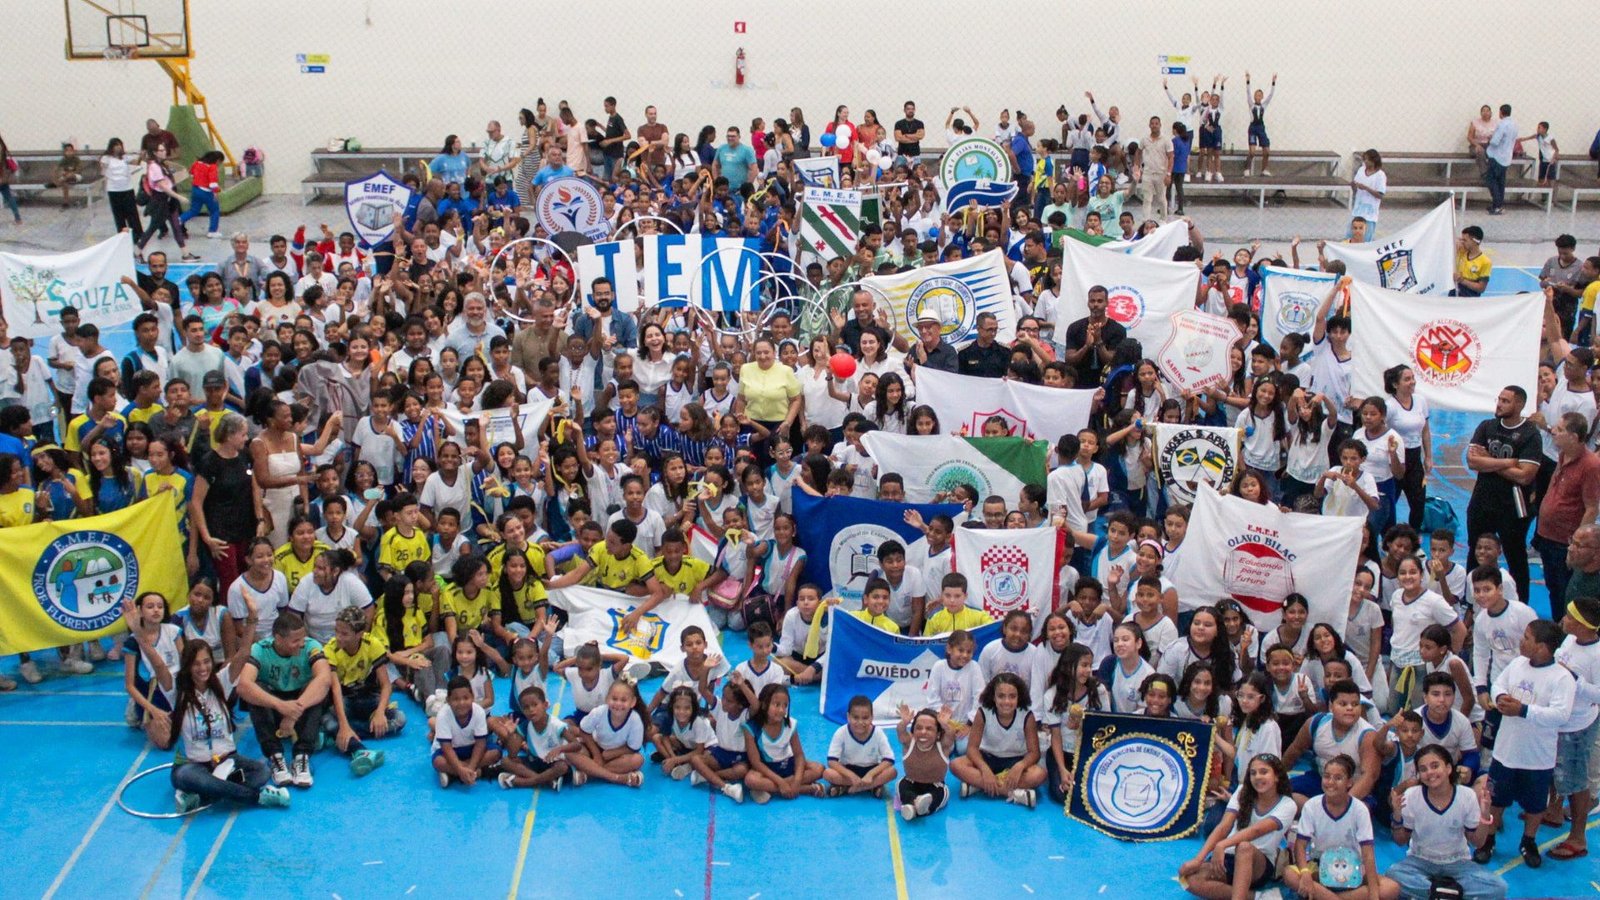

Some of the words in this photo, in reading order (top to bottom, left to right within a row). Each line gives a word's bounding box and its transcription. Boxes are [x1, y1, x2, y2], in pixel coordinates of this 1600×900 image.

[363, 183, 397, 194] EMEF
[46, 278, 129, 317] SOUZA
[1165, 359, 1186, 383] SABINO
[1191, 373, 1223, 389] RIBEIRO
[1164, 430, 1194, 456] NOSSA
[1206, 432, 1234, 483] APARECIDA
[396, 549, 409, 561] 25
[1228, 534, 1261, 548] OLAVO
[1265, 537, 1297, 562] BILAC
[1239, 557, 1283, 571] Educando
[291, 571, 300, 587] 5
[1236, 574, 1267, 586] futuro
[46, 604, 122, 630] FLORENTINO
[459, 610, 468, 625] 6
